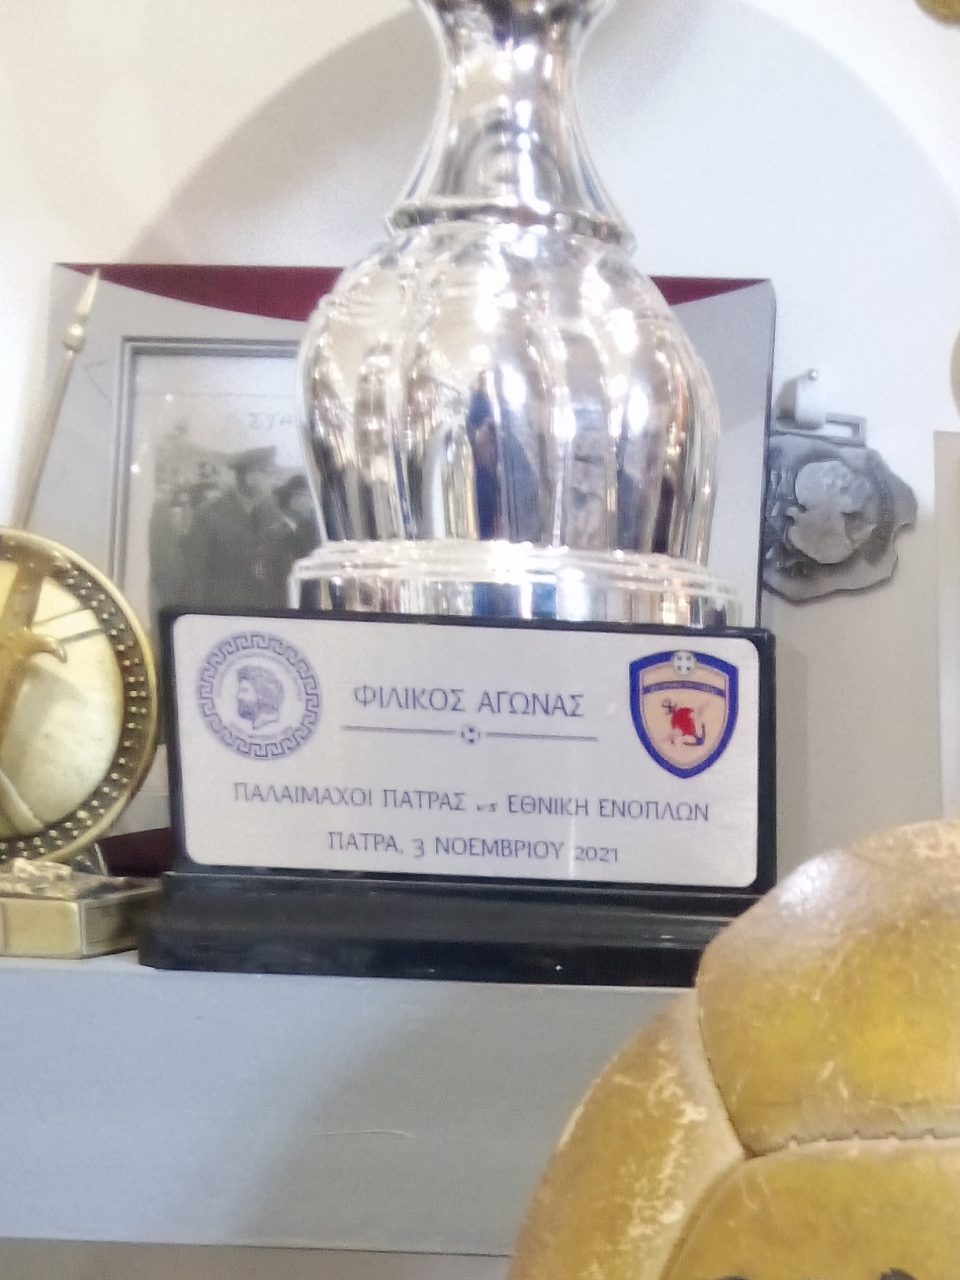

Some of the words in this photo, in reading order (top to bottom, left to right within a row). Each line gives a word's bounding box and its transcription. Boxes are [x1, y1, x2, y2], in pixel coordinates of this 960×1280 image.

[353, 684, 466, 713] ΦΙΛΙΚΟΣ
[477, 690, 585, 718] ΑΓΩΝΑΣ
[233, 782, 373, 808] ΠΑΛΑΙΜΑΧΟΙ
[382, 789, 467, 812] ΠΑΤΡΑΣ
[507, 794, 589, 817] ΕΘΝΙΚΗ
[599, 798, 710, 823] ΕΝΟΠΛΩΝ
[411, 838, 425, 859] 3
[434, 836, 565, 861] ΝΟΕΜΒΡΙΟΥ
[574, 846, 619, 863] 2021
